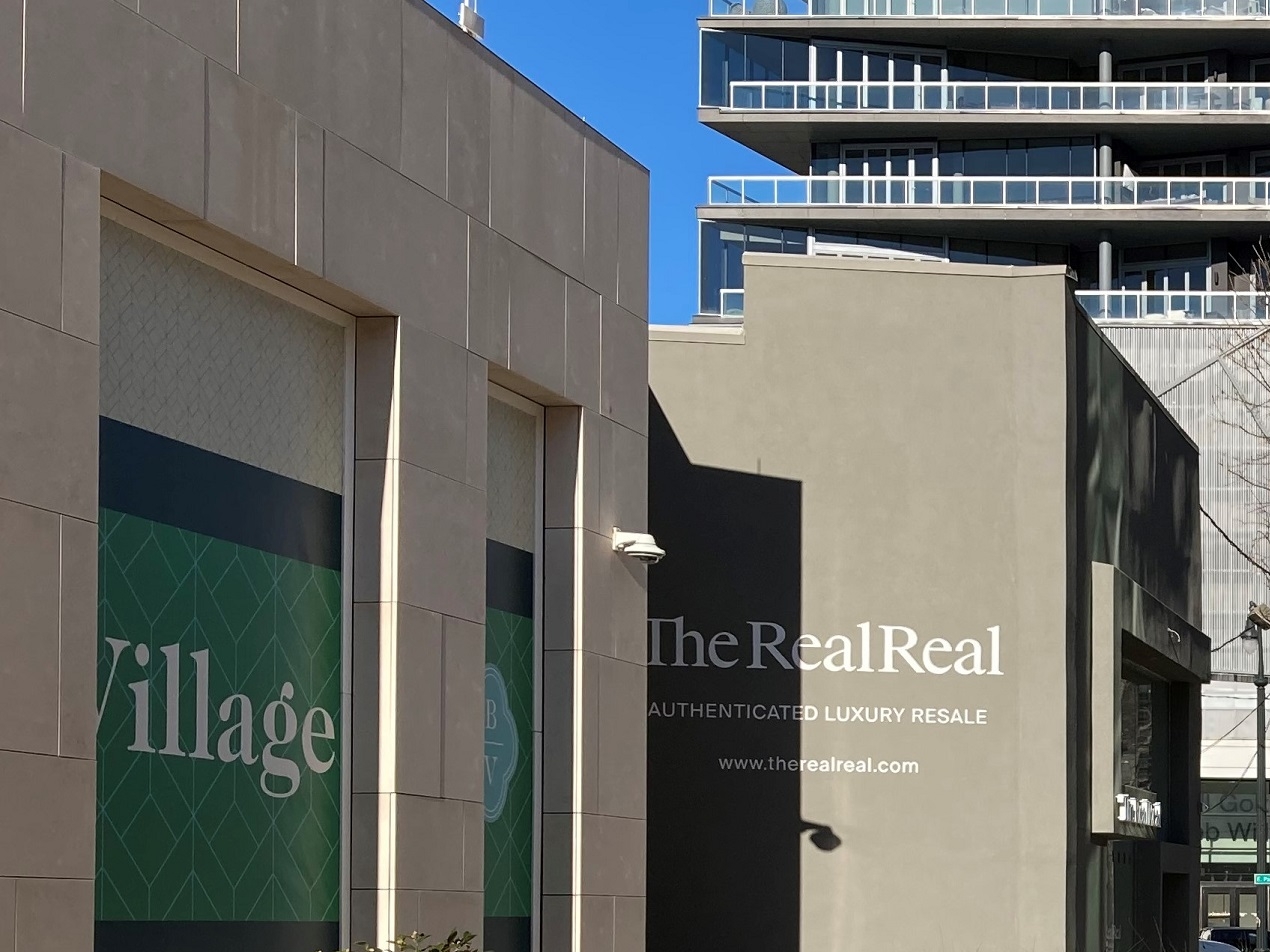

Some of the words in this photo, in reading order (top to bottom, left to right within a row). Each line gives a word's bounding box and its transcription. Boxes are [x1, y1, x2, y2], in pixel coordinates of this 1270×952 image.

[647, 616, 740, 669] The
[746, 620, 1005, 676] RealReal
[648, 702, 819, 721] AUTHENTICATED
[824, 705, 905, 723] LUXURY
[911, 708, 988, 725] RESALE
[718, 756, 919, 774] www.therealreal.com
